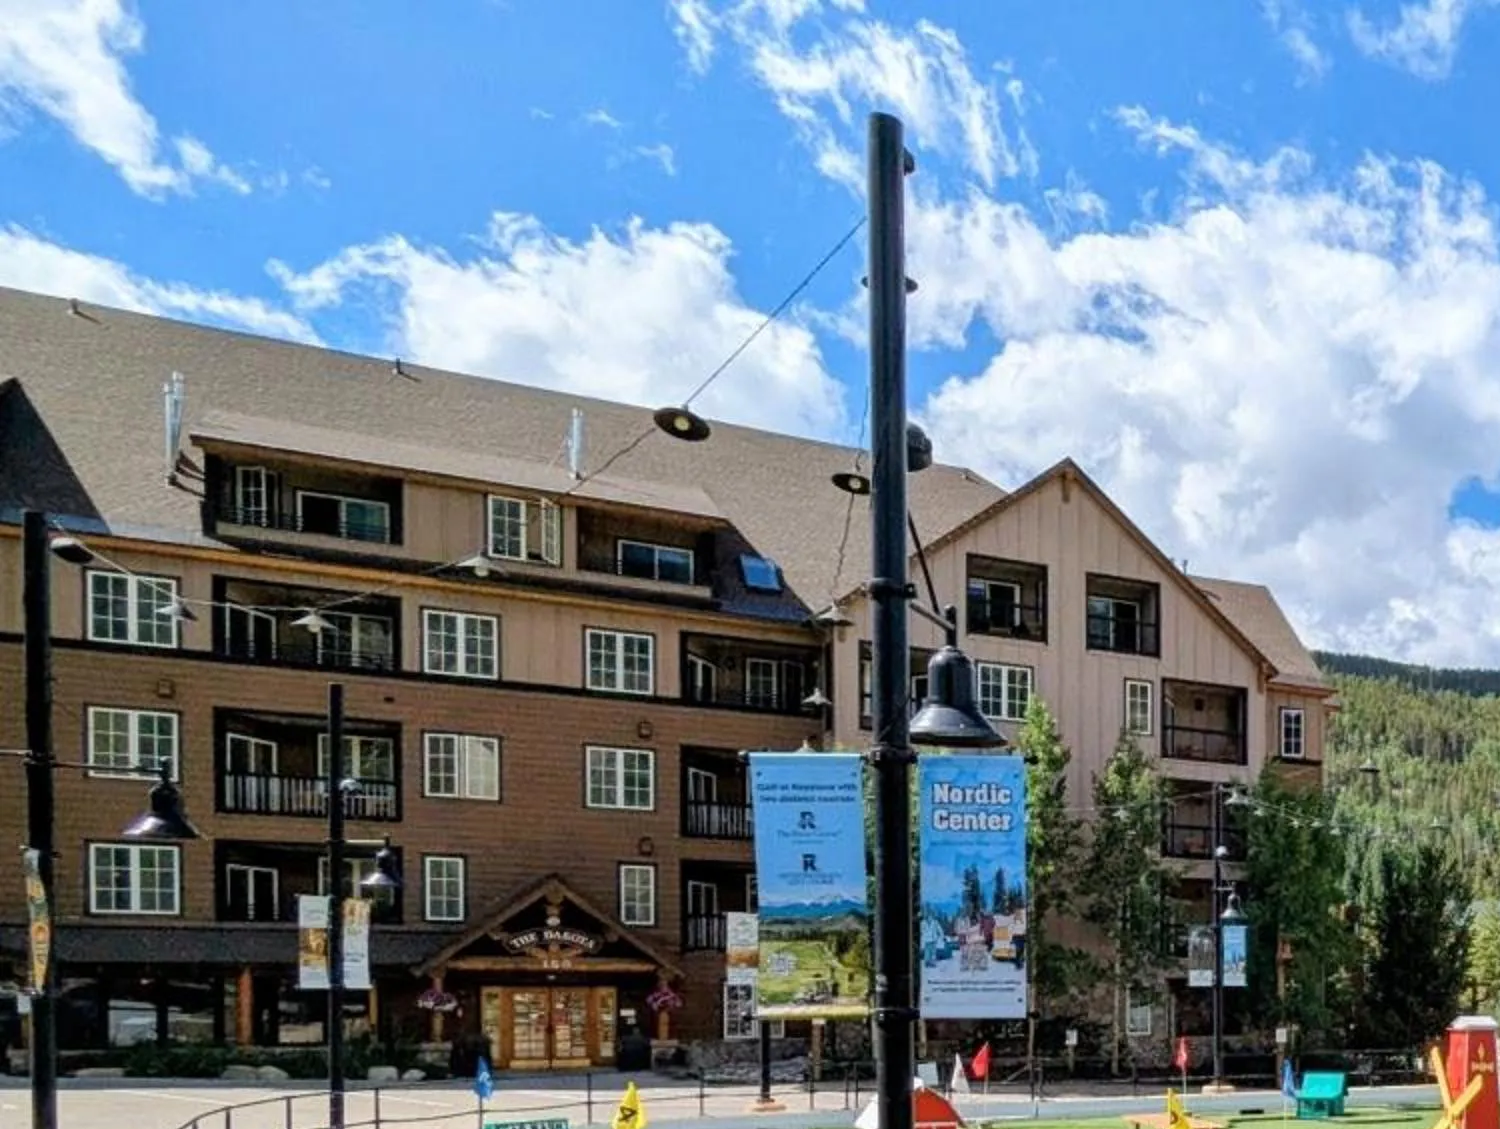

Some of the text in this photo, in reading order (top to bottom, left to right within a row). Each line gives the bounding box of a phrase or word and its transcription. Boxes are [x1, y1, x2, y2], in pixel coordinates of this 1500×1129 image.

[933, 783, 1011, 804] Nordic
[933, 809, 1011, 831] Center
[510, 931, 537, 949] THE
